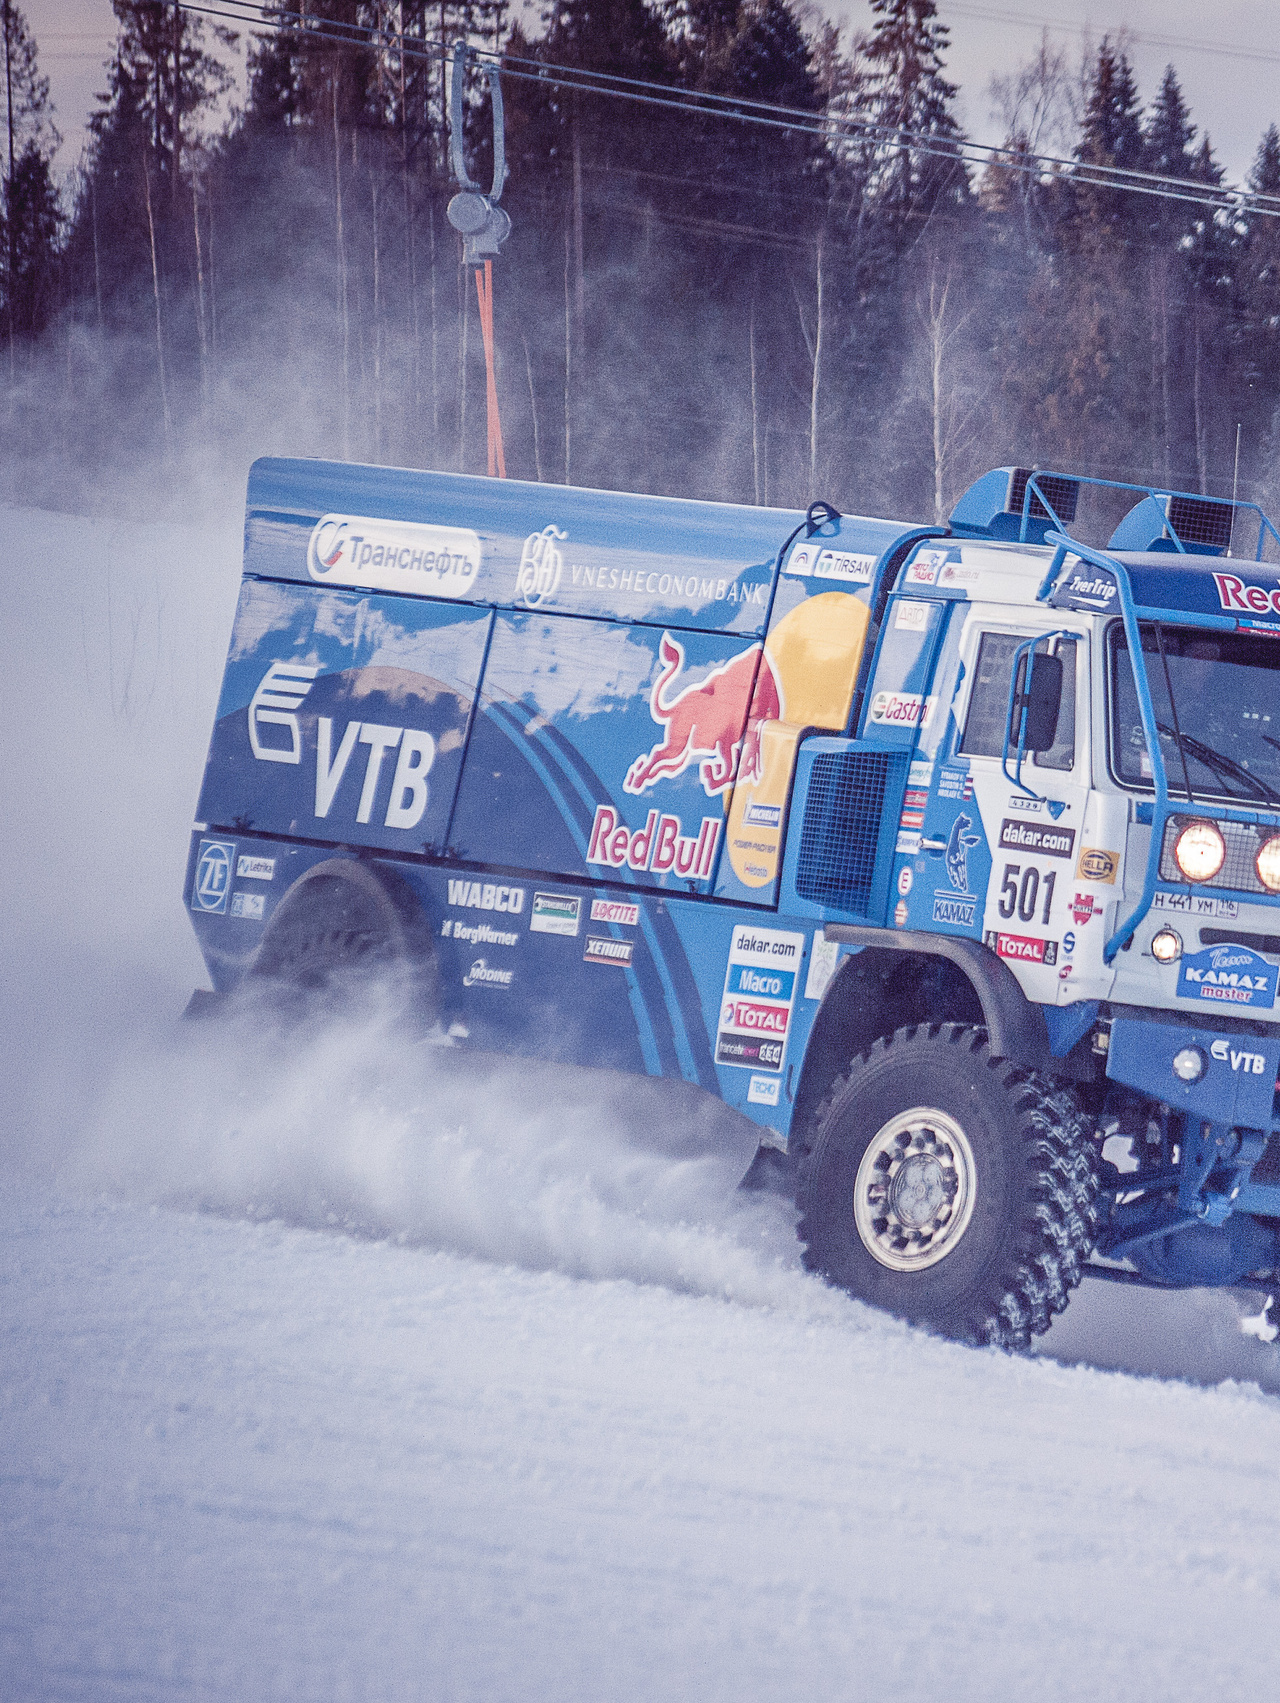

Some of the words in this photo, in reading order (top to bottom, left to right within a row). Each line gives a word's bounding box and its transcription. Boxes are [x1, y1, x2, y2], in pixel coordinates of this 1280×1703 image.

[350, 536, 473, 580] Транснефть
[572, 565, 767, 605] VNESHECONOMBANK
[1069, 576, 1117, 600] TverTrip
[886, 697, 932, 723] Castrol
[314, 717, 436, 830] VTB
[1002, 824, 1071, 851] dakar.com
[199, 857, 229, 896] ZF
[1082, 860, 1113, 874] HELLA
[448, 879, 524, 914] WABCO
[998, 863, 1057, 926] 501
[592, 902, 637, 922] LOCTITE
[932, 899, 975, 927] KAMAZ
[453, 921, 518, 946] BorgWarner
[737, 934, 795, 957] dakar.com
[1000, 936, 1041, 958] TOTAL
[1210, 947, 1253, 969] Team
[469, 967, 512, 983] MODINE
[739, 970, 780, 994] Macro
[1186, 967, 1268, 991] KAMAZ
[1201, 986, 1252, 1002] master
[737, 1005, 786, 1031] TOTAL
[1228, 1049, 1264, 1075] VTB
